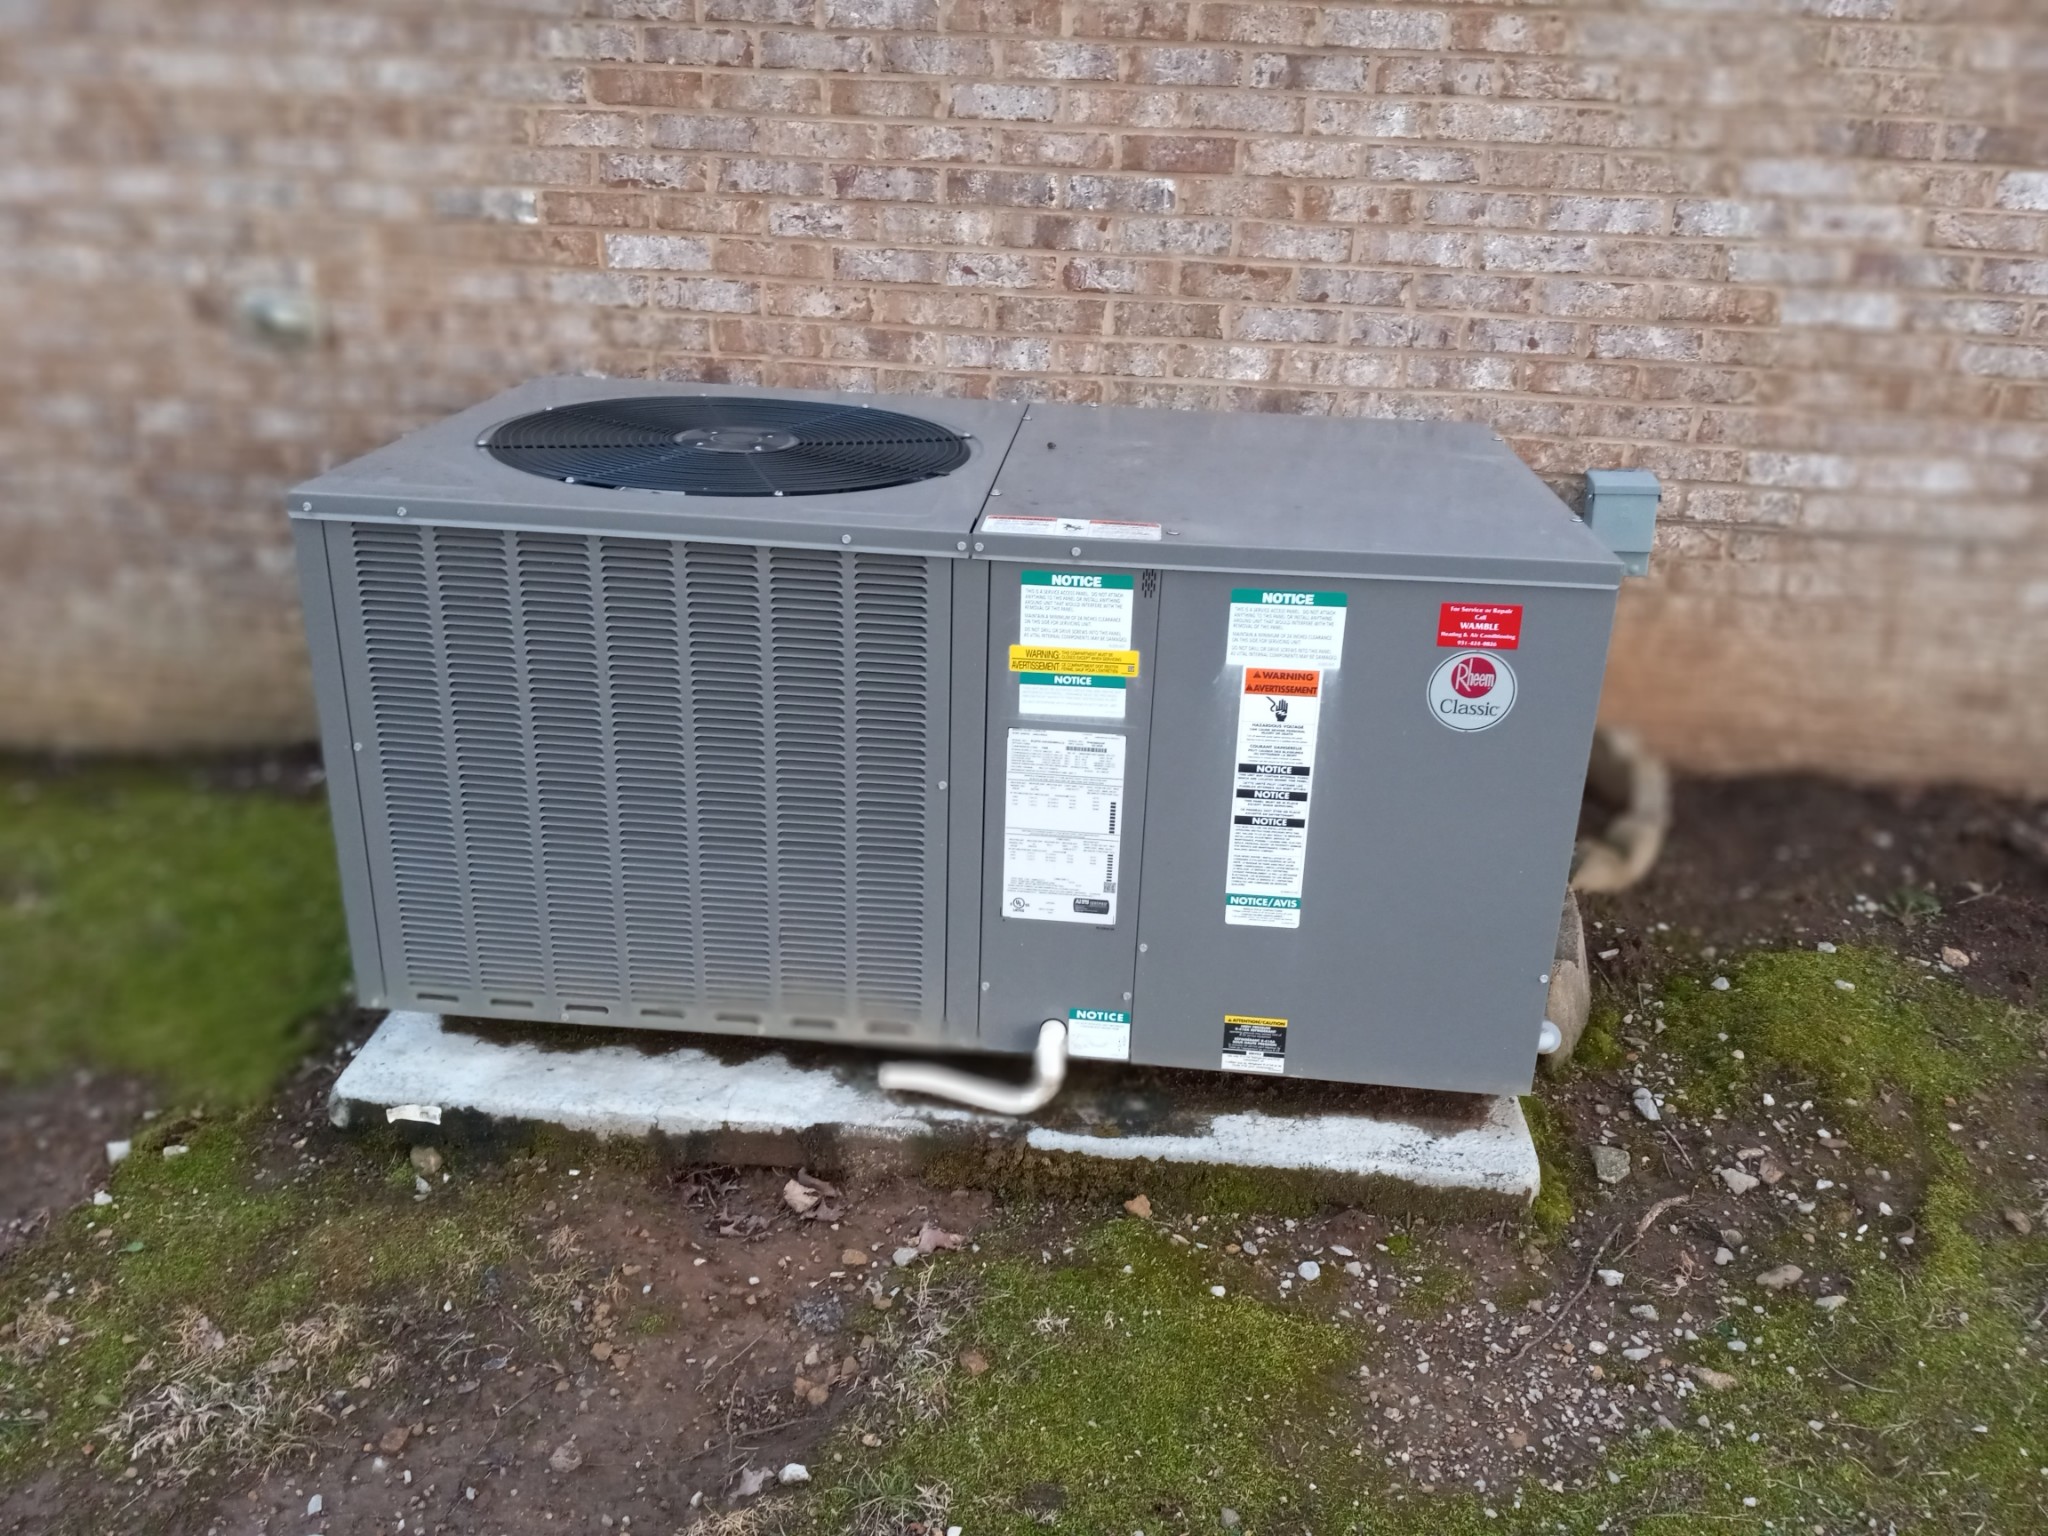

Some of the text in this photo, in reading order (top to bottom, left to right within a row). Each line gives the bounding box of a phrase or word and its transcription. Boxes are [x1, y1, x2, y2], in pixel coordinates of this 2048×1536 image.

[1051, 574, 1102, 587] NOTICE
[1262, 592, 1315, 605] NOTICE
[1460, 622, 1499, 631] WAMBLE
[1262, 671, 1314, 680] WARNING
[1455, 658, 1494, 692] Rheem
[1054, 676, 1092, 685] NOTICE
[1253, 684, 1318, 694] AVERTISSEMENT
[1440, 698, 1500, 716] Classic
[1256, 765, 1292, 774] NOTICE
[1254, 790, 1290, 800] NOTICE
[1252, 817, 1288, 826] NOTICE
[1230, 896, 1298, 908] NOTICE/AVIS
[1076, 1010, 1124, 1022] NOTICE
